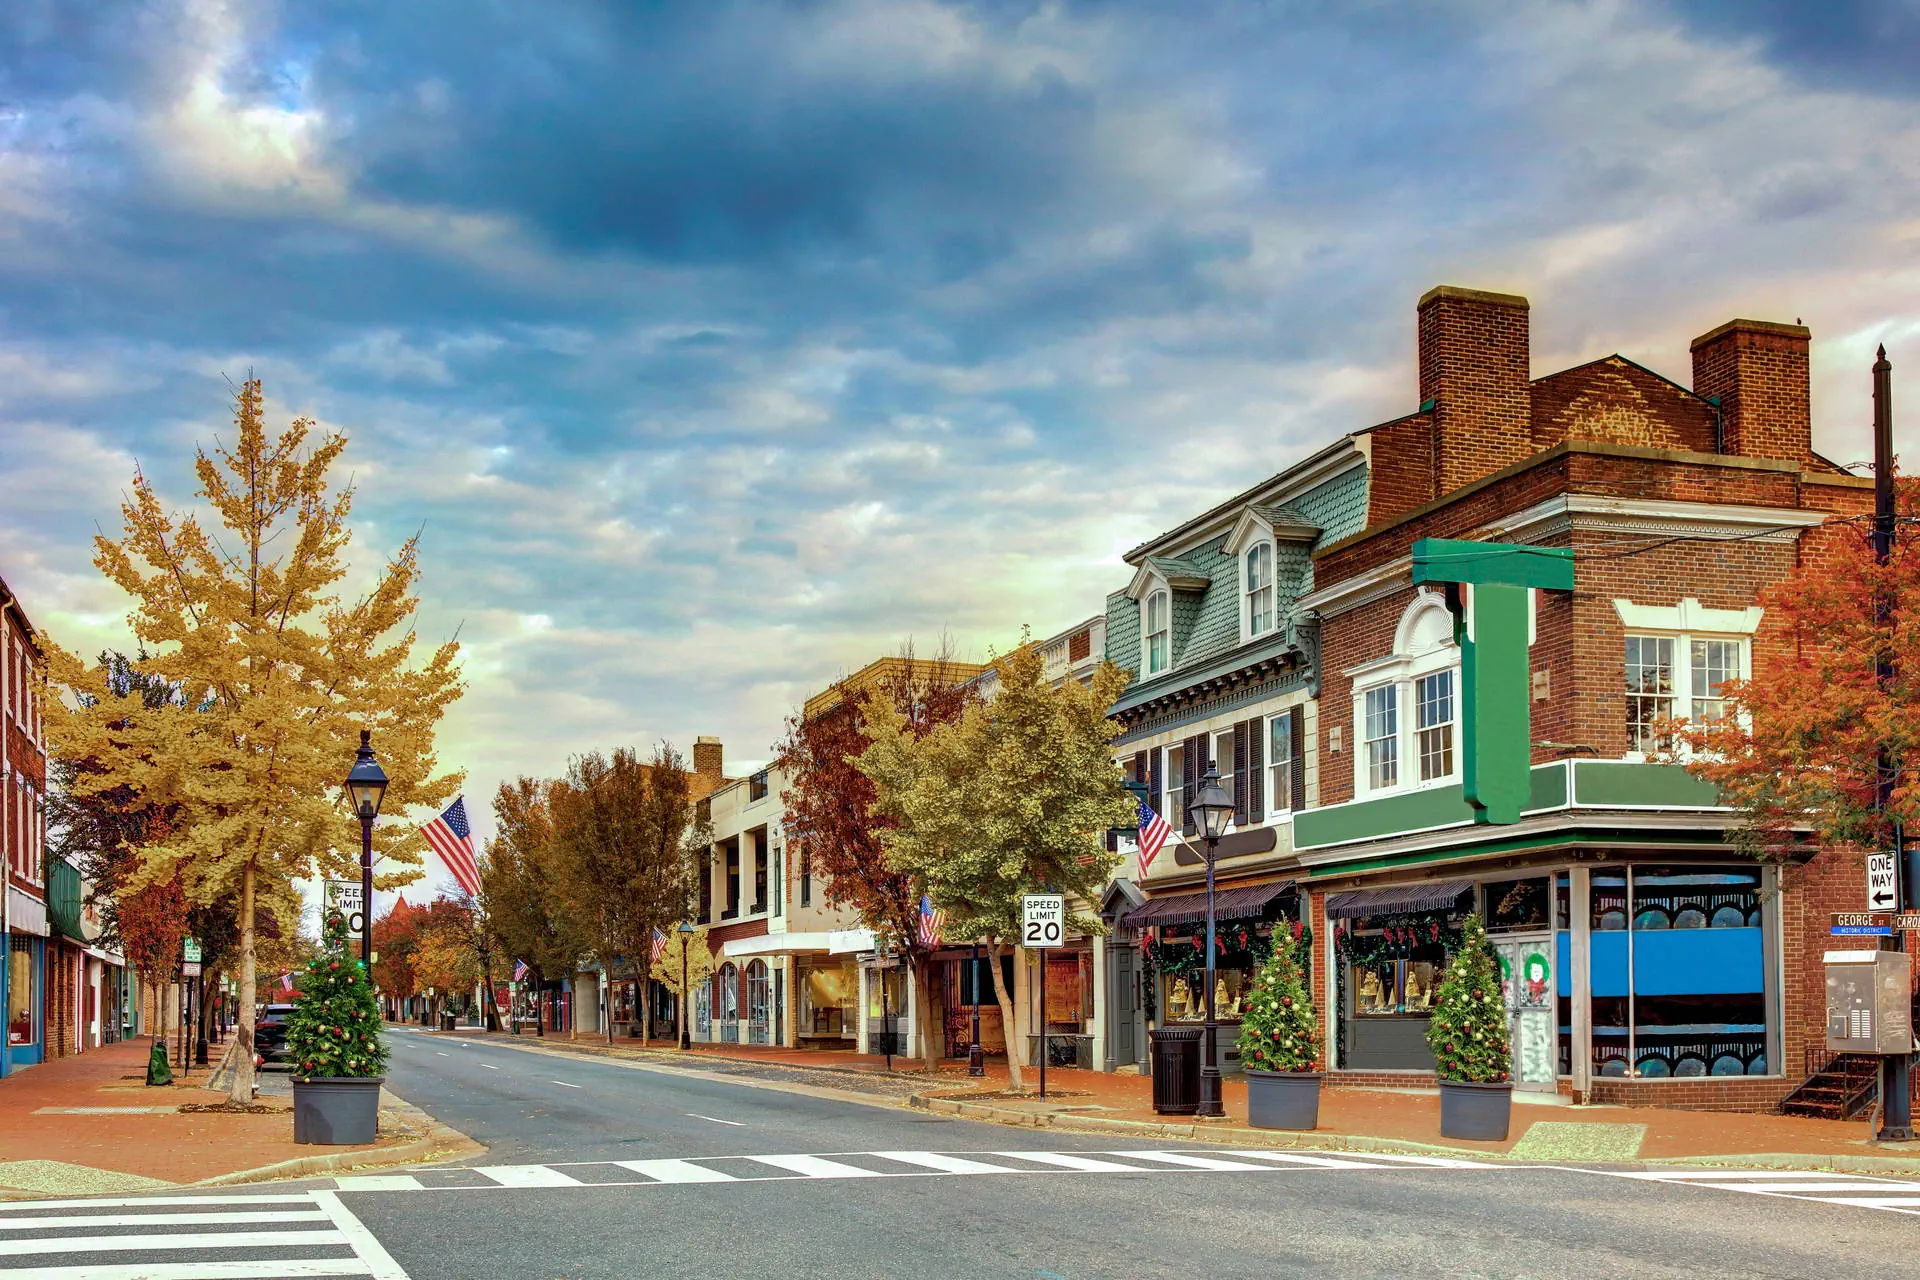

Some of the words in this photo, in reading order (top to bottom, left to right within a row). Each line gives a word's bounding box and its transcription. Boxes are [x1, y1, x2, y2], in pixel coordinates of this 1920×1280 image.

[1870, 856, 1892, 872] ONE
[1871, 873, 1893, 888] WAY
[339, 899, 364, 909] IMIT
[1026, 900, 1060, 909] SPEED
[1030, 911, 1056, 920] LIMIT
[1838, 914, 1874, 926] GEORGE
[1027, 922, 1060, 941] 20
